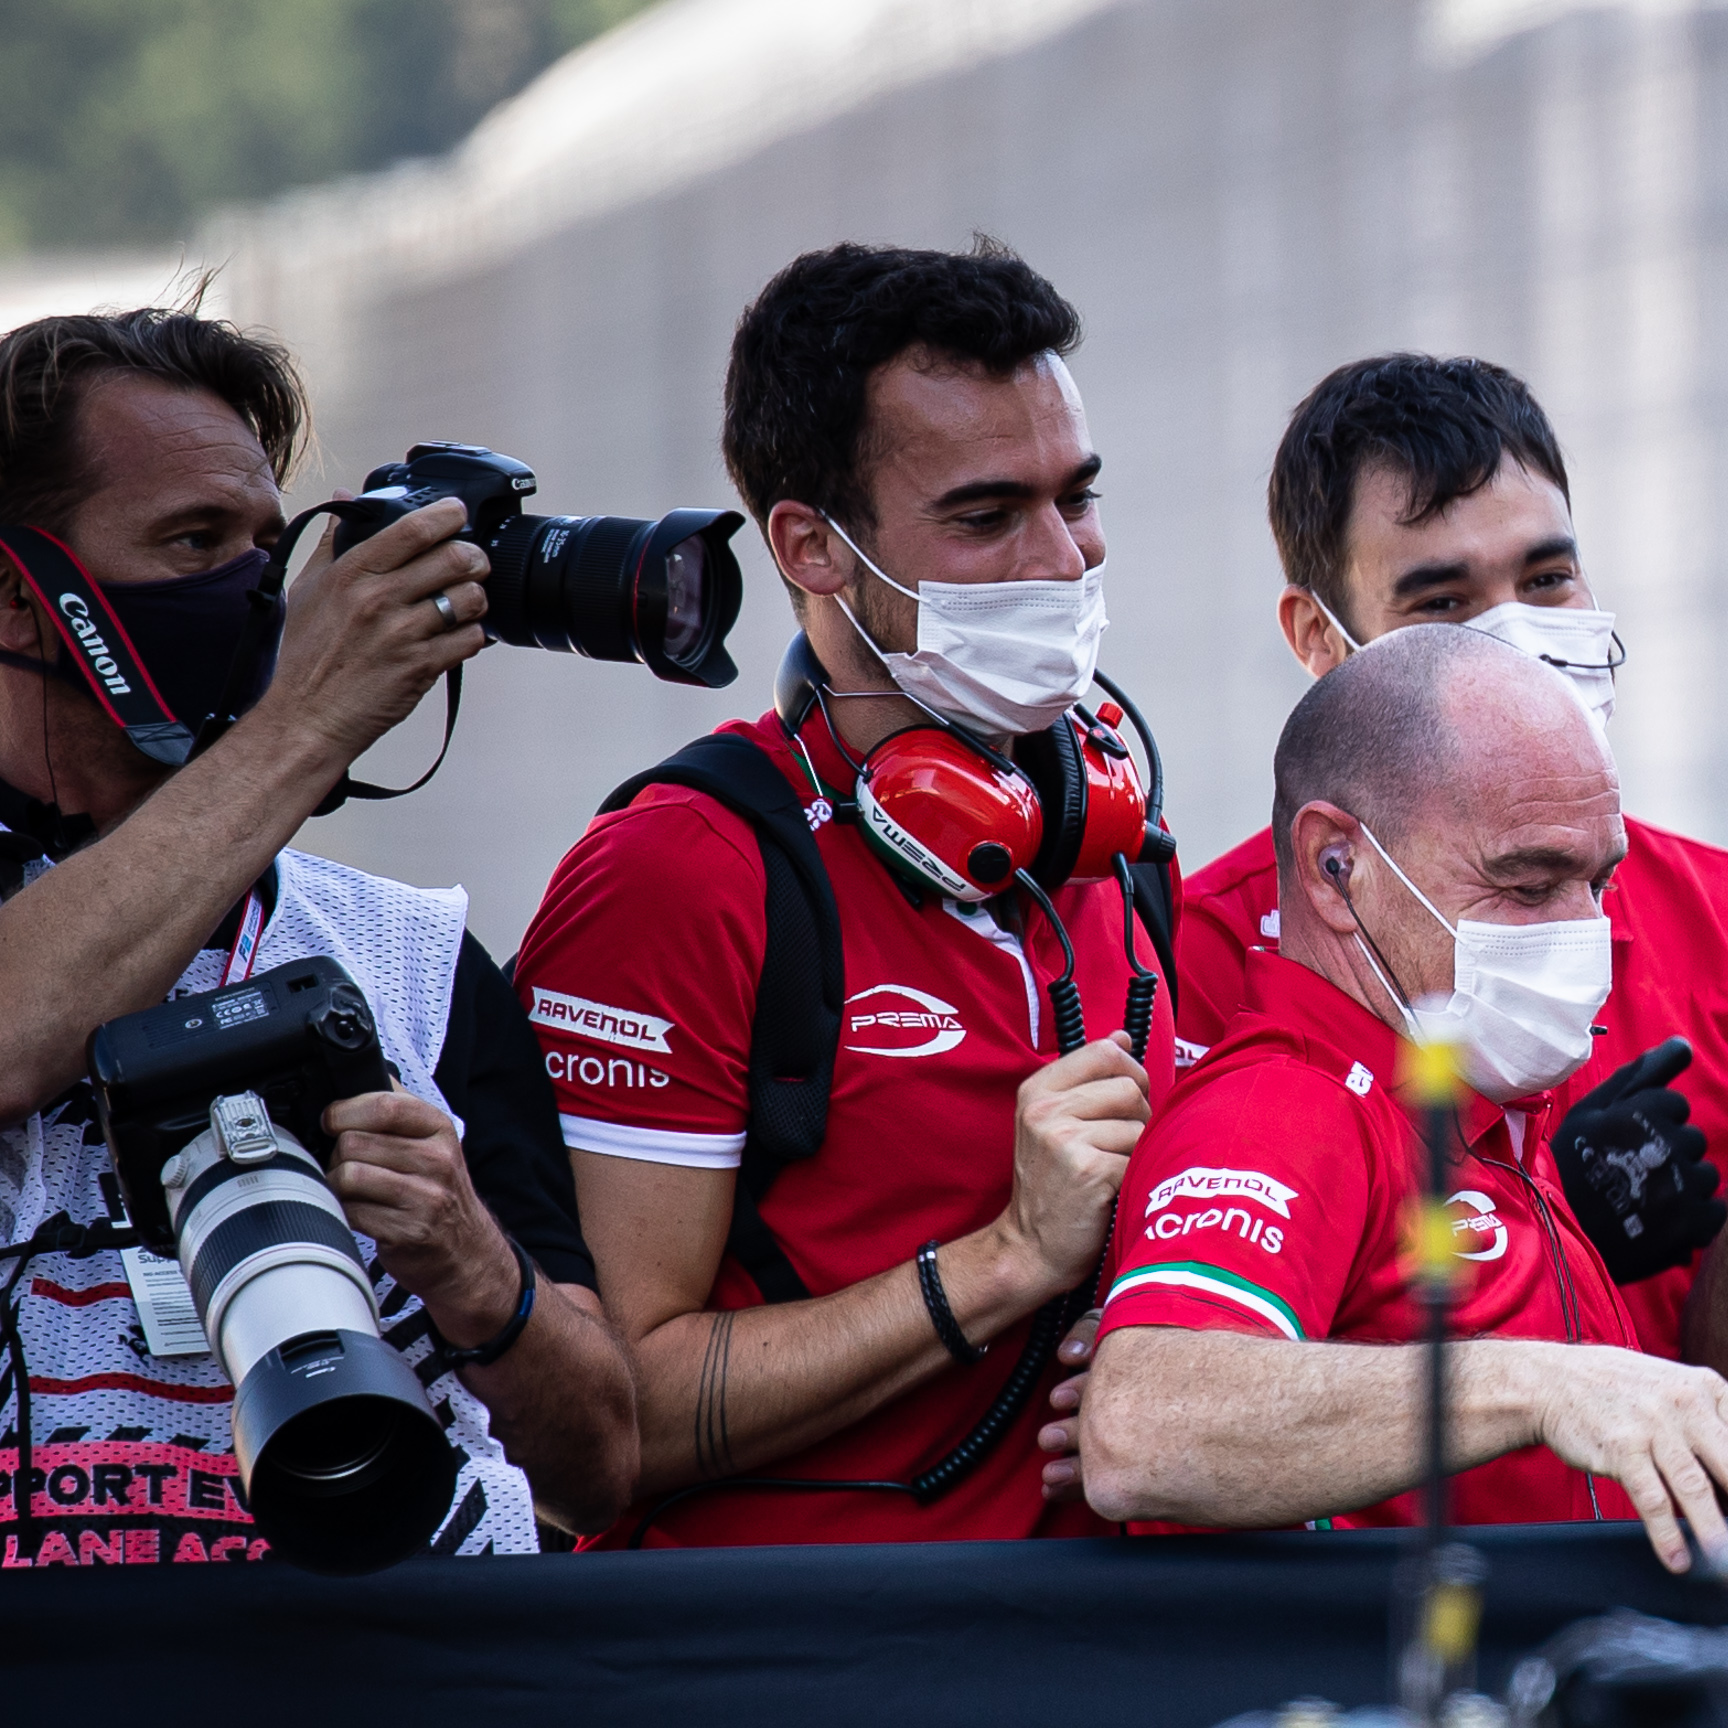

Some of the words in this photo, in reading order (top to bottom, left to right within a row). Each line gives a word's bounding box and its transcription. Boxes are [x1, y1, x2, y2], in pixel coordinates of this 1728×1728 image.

[58, 592, 132, 695] Canon
[872, 804, 967, 893] PREMA
[537, 997, 658, 1043] RAVENOL
[850, 1011, 964, 1033] PREMA
[1157, 1173, 1279, 1203] RAVENOL
